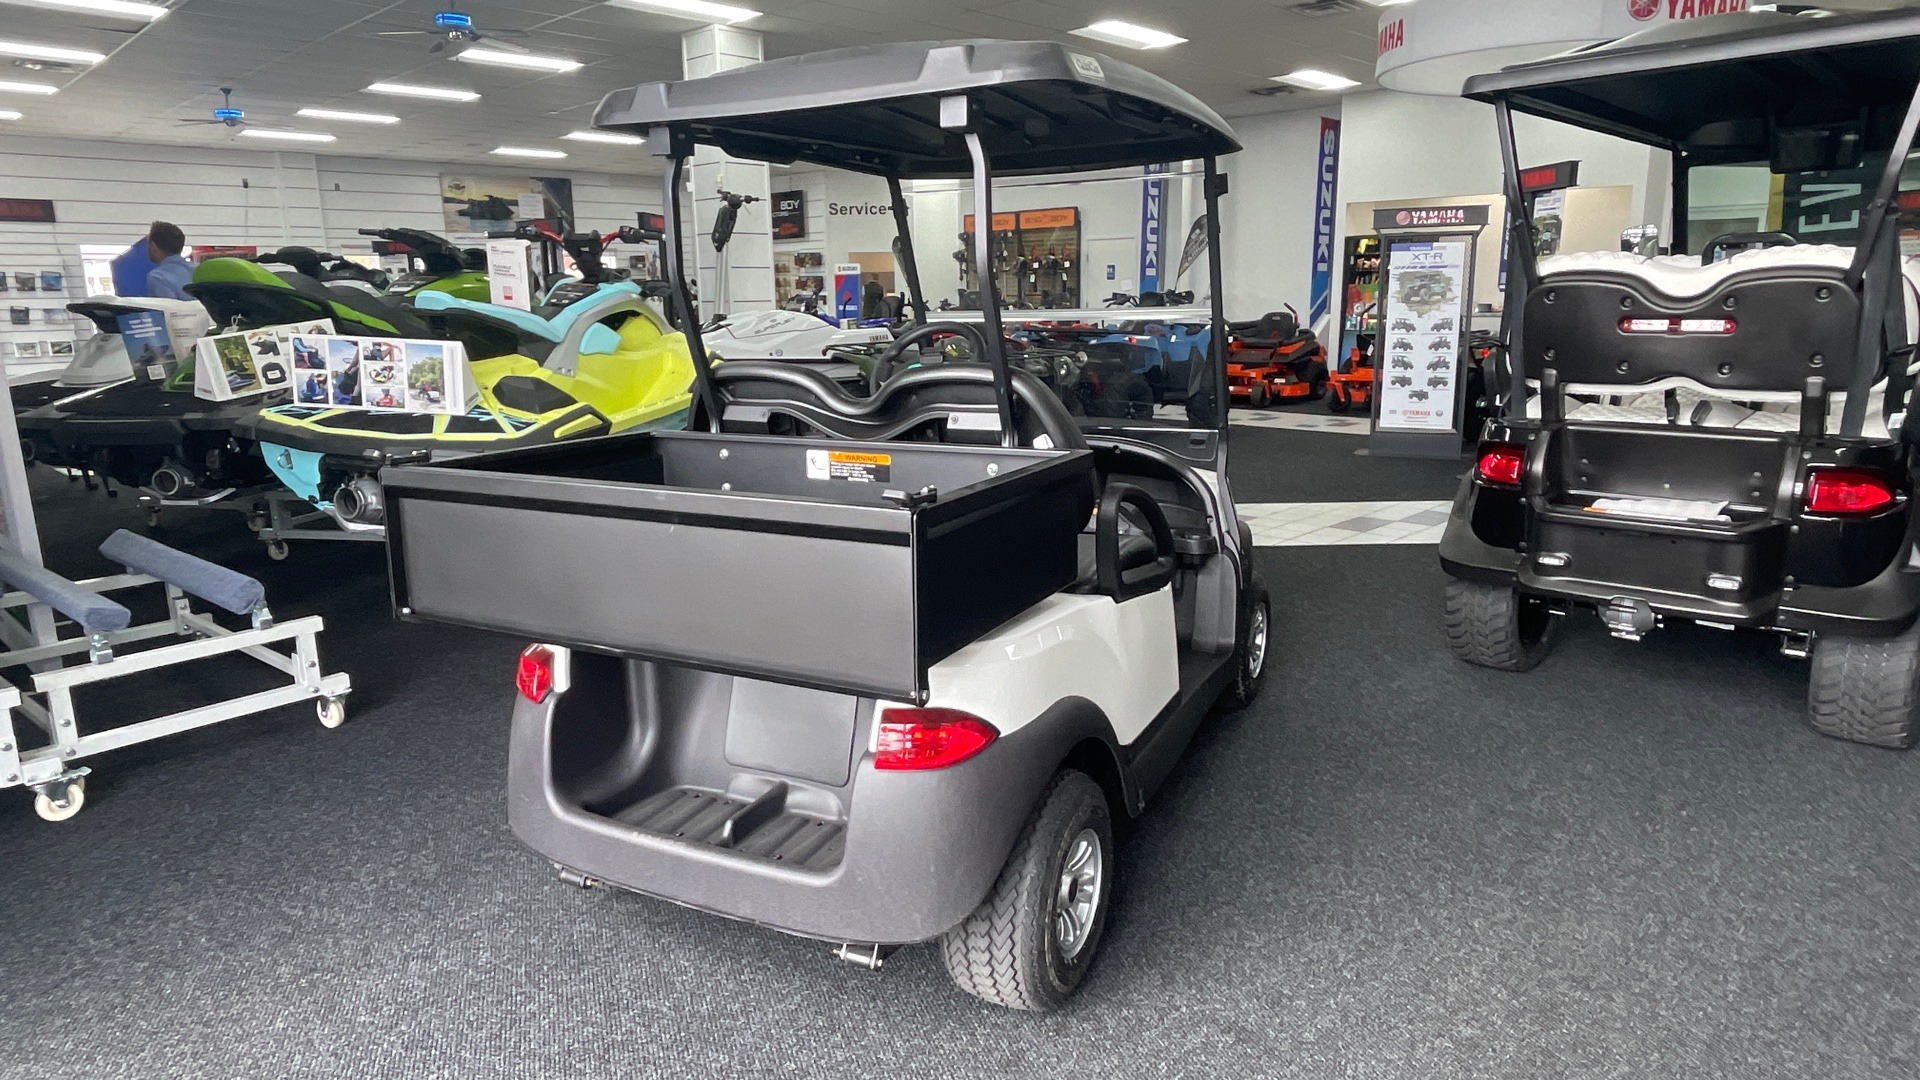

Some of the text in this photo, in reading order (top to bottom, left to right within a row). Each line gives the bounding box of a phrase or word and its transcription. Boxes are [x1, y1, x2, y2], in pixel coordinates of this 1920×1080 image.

[780, 200, 800, 211] BOY
[1317, 128, 1335, 272] SUZUKI
[828, 202, 888, 216] Service
[1411, 209, 1465, 225] YAMAHA
[1411, 252, 1444, 261] XT-R
[845, 454, 878, 463] WARNING
